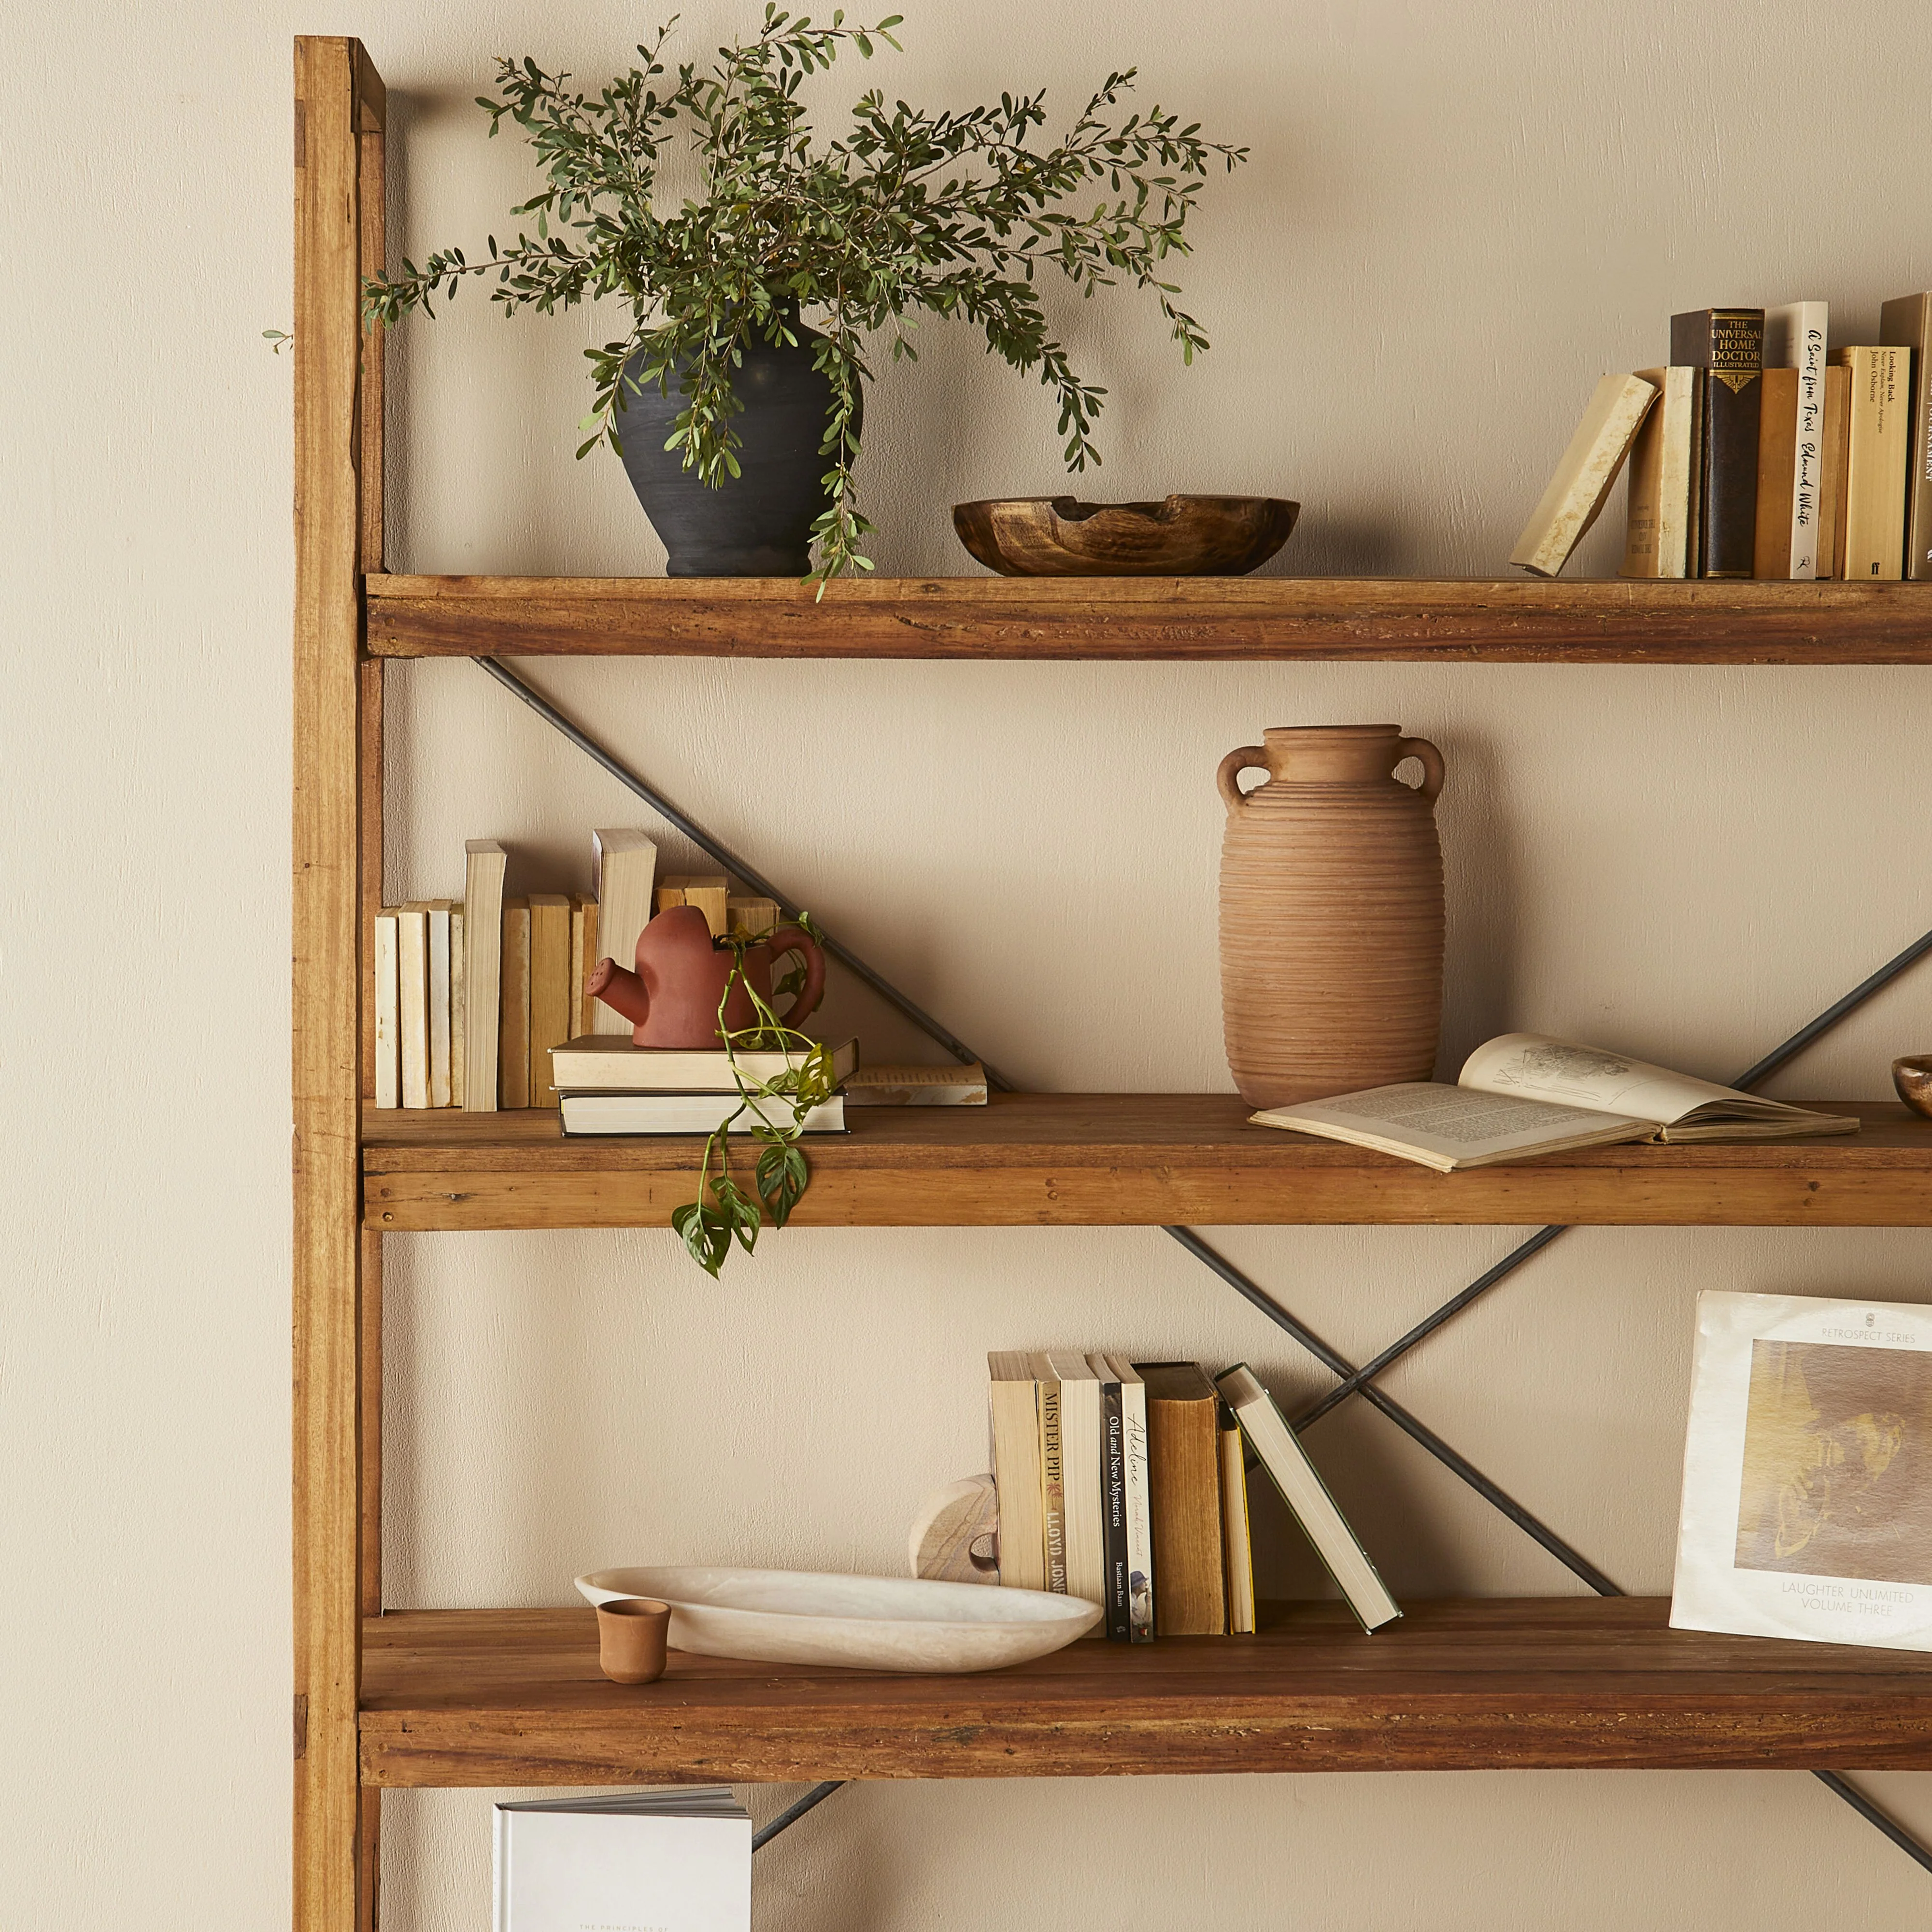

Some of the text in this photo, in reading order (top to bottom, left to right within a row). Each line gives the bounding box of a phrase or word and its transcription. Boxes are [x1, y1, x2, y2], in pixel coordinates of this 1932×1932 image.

[1711, 329, 1762, 339] UNIVERSAL
[1719, 340, 1755, 350] HOME
[1711, 351, 1761, 361] DOCTOR
[1887, 351, 1896, 382] Looking
[1802, 330, 1822, 432] A Saint from Texas
[1870, 350, 1878, 402] John Osborne
[1798, 442, 1815, 527] Edmund White
[1822, 1328, 1915, 1343] RETROSPECT SERIES
[1045, 1393, 1060, 1481] MISTER PIP
[1126, 1413, 1147, 1486] Adeline
[1109, 1416, 1122, 1527] Old and New Mysteries
[1047, 1512, 1062, 1556] LLOYD
[1134, 1524, 1144, 1557] Vincent
[1782, 1582, 1914, 1604] LAUGHTER UNLIMITED
[1801, 1598, 1893, 1617] VOLUME THREE
